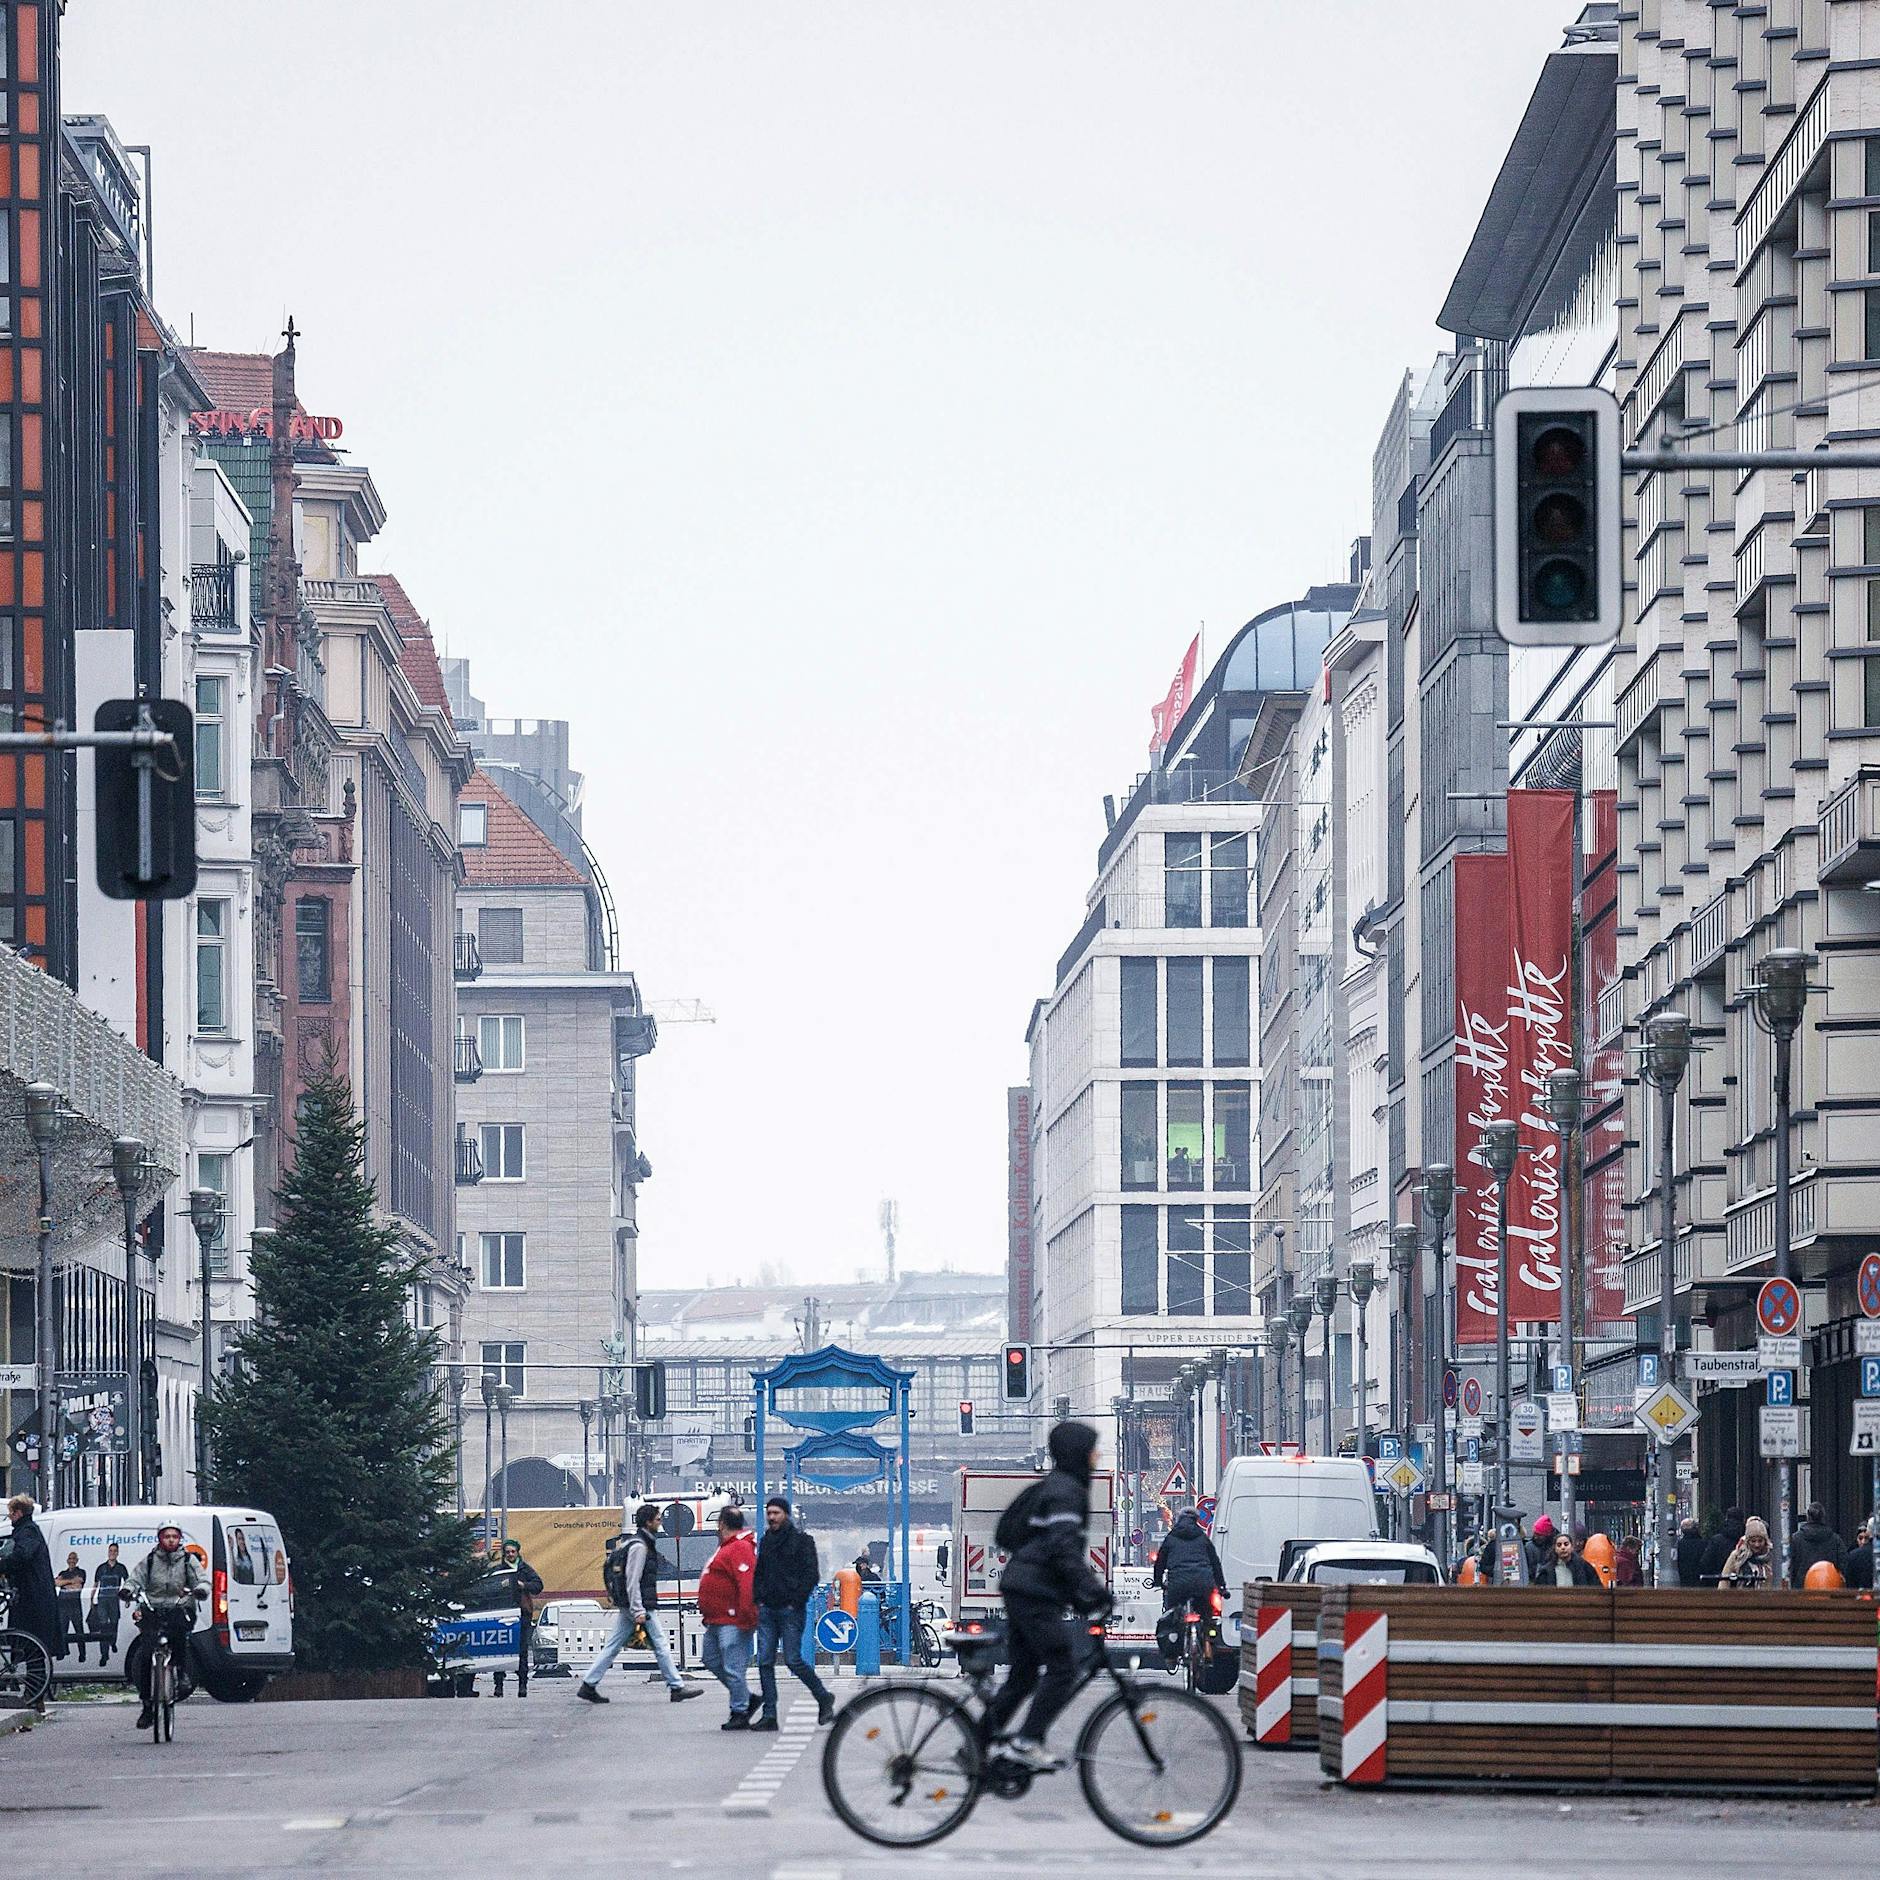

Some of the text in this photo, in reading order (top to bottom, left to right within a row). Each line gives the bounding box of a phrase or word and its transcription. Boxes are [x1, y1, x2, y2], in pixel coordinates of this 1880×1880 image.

[187, 407, 344, 440] STIN GAND
[1455, 1000, 1510, 1316] Galeries Lfayette
[1507, 1145, 1562, 1291] Galeries
[1018, 1268, 1030, 1341] ussmann
[1148, 1334, 1184, 1343] UPPER
[1188, 1334, 1243, 1343] EASTSIDE
[1693, 1358, 1763, 1373] Taubenstraß
[0, 1371, 22, 1383] raße
[70, 1535, 103, 1546] Echte
[446, 1629, 513, 1647] POLIZEI
